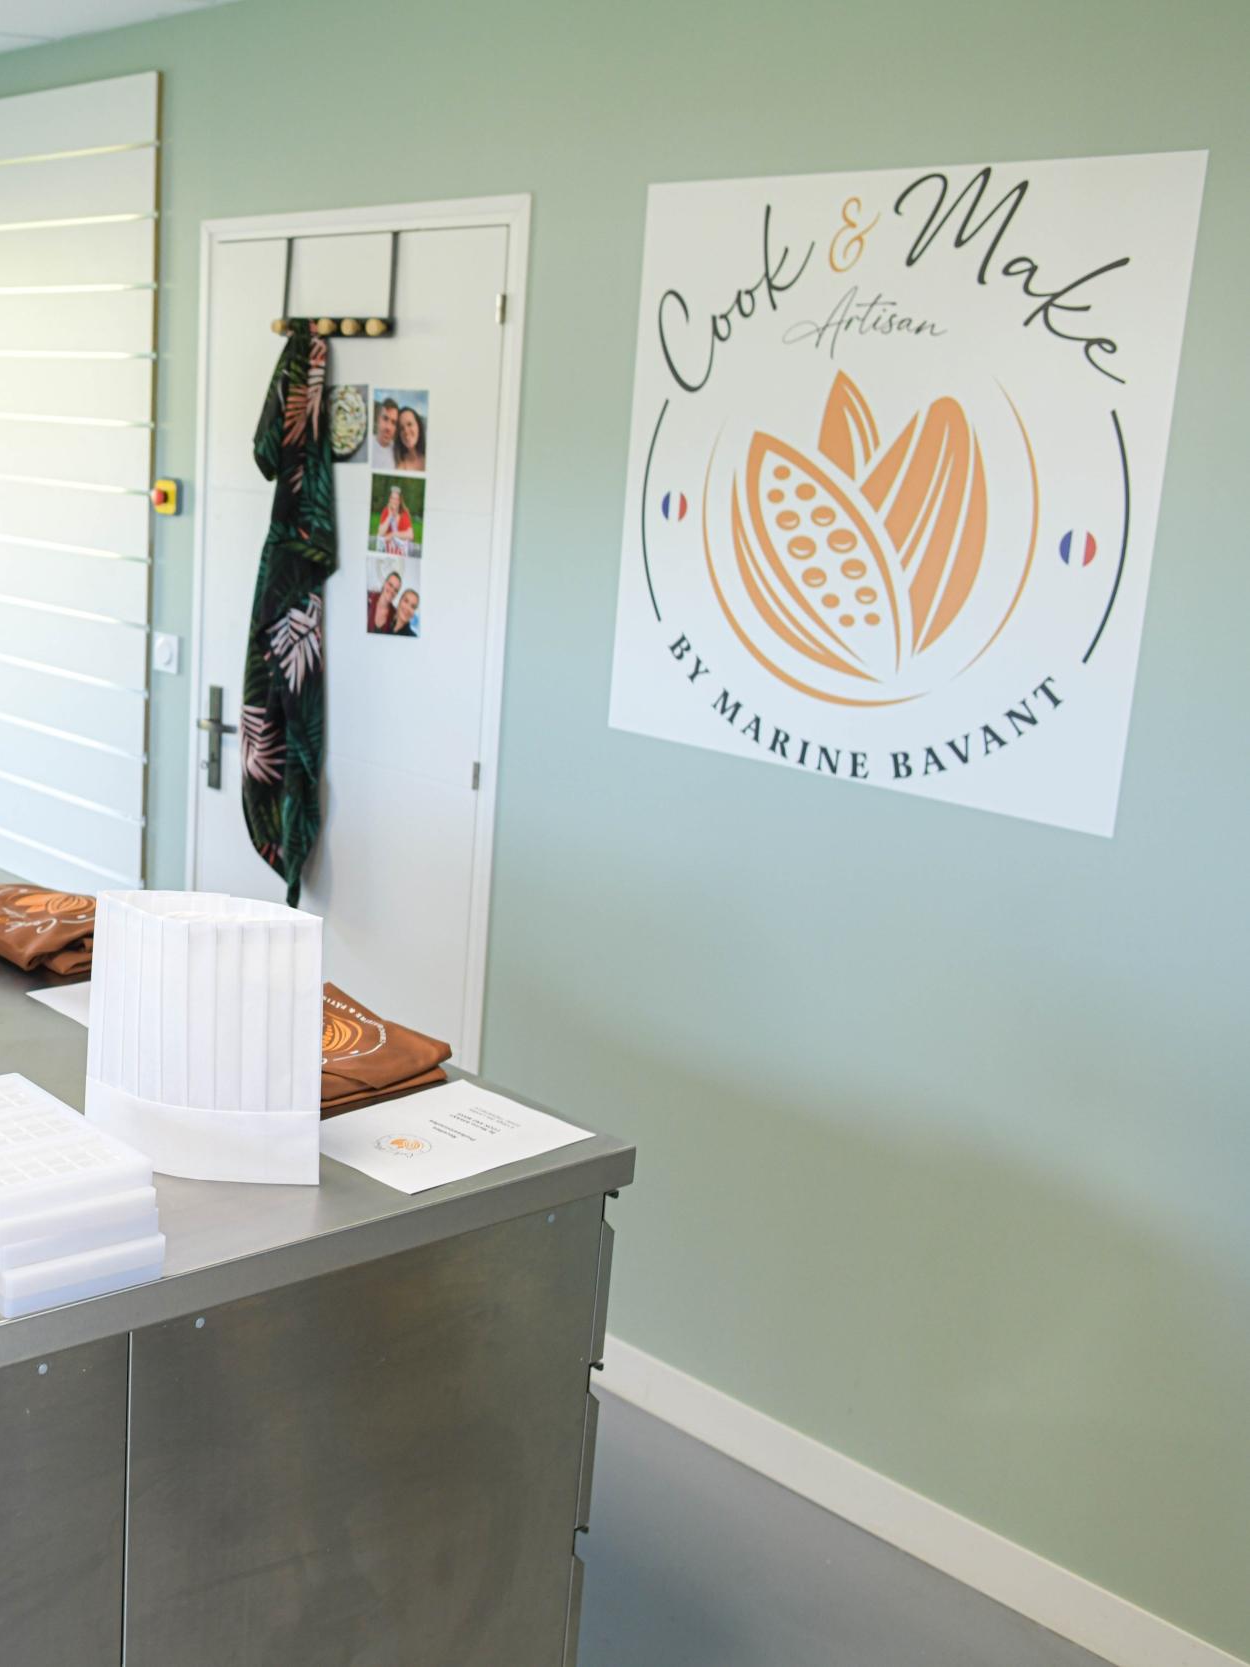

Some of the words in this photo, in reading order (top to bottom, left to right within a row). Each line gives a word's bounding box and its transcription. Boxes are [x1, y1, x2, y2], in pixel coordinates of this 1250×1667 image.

[658, 203, 815, 392] Cook
[828, 196, 881, 273] &
[893, 166, 1130, 384] Make
[782, 285, 948, 359] Artisan
[667, 633, 711, 686] BY
[710, 688, 869, 780] MARINE
[891, 676, 1065, 780] BAVANT
